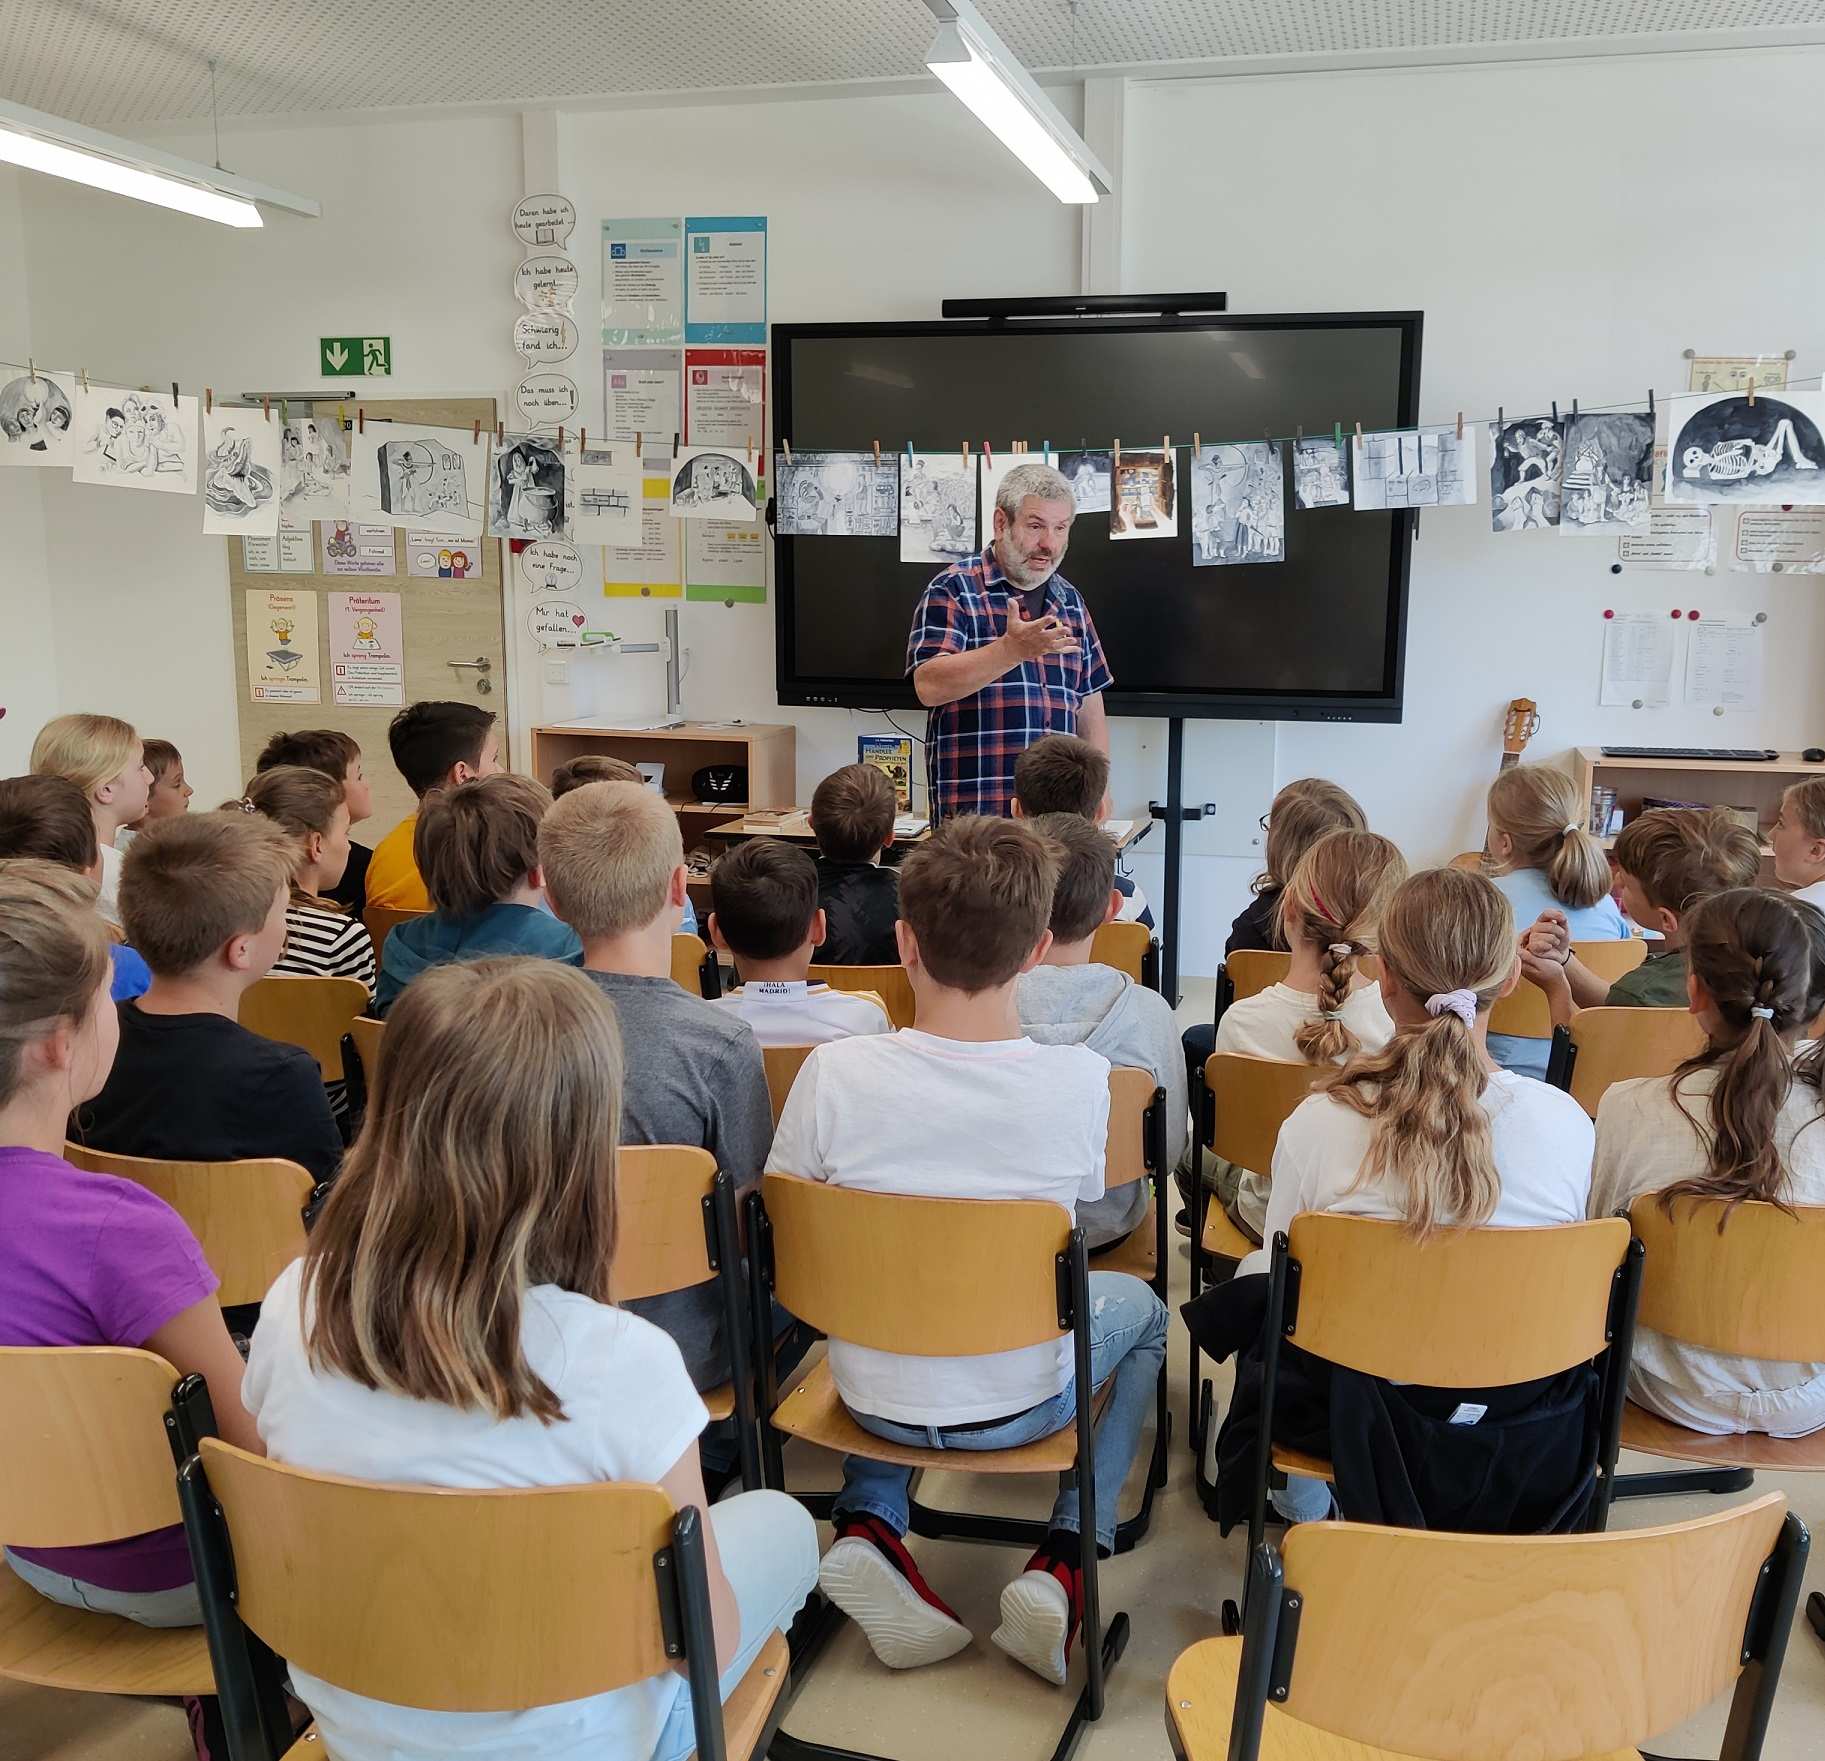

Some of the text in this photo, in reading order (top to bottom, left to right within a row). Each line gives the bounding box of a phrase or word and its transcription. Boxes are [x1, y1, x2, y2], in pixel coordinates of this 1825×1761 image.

[543, 207, 556, 215] habe
[561, 206, 569, 214] ich
[515, 220, 531, 230] heute
[521, 264, 574, 276] Ich habe heute
[522, 323, 560, 337] Schwierig
[522, 340, 542, 350] fand
[521, 385, 534, 394] Das
[559, 385, 569, 393] ich
[523, 399, 540, 407] noch
[530, 547, 578, 562] Ich habe noch
[349, 596, 382, 605] Präteritum
[536, 606, 569, 618] Mir hat
